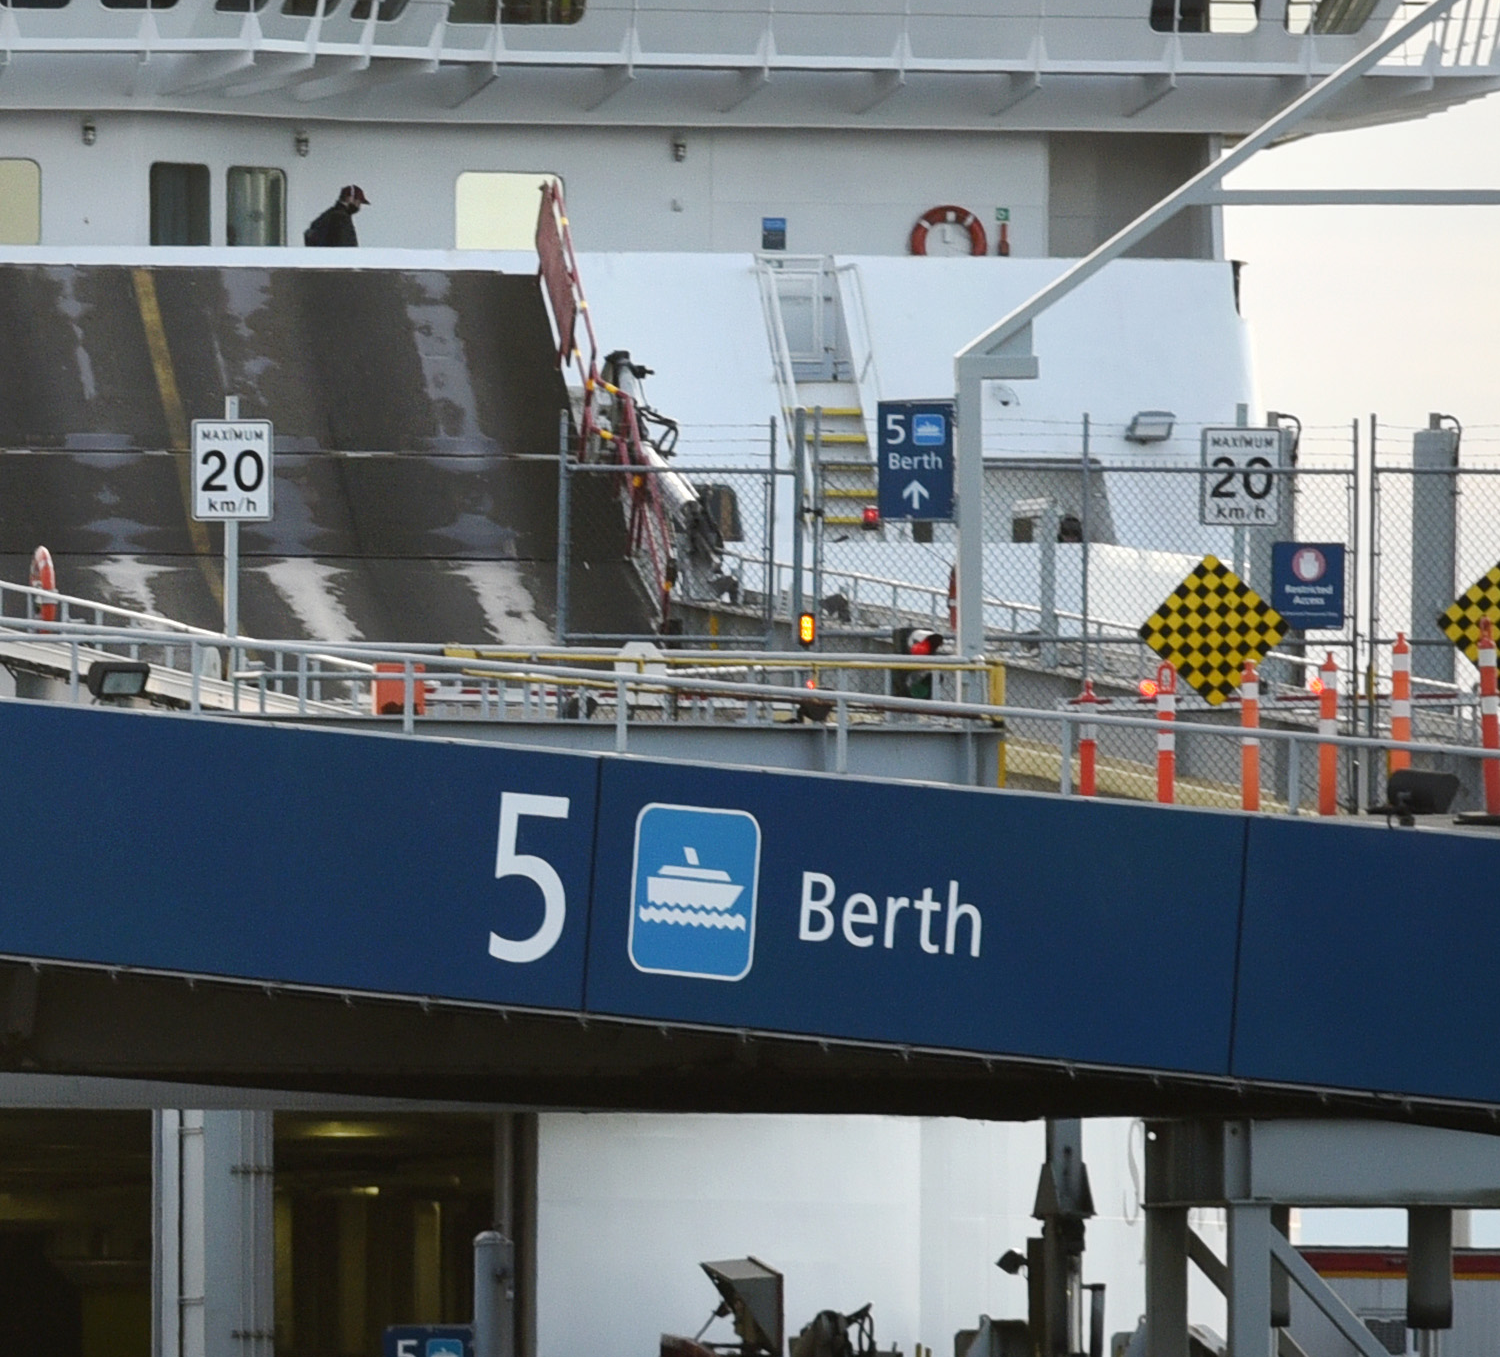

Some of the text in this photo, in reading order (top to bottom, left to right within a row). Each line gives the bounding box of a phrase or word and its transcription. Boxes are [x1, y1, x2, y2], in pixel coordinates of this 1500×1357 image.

[201, 427, 264, 441] MAXIMUM
[886, 414, 906, 445] 5
[1212, 436, 1274, 449] MAXIMUM
[201, 449, 264, 492] 20
[888, 451, 943, 470] Berth
[1211, 456, 1273, 500] 20
[208, 496, 257, 512] km/h
[488, 791, 982, 963] 5 Berth
